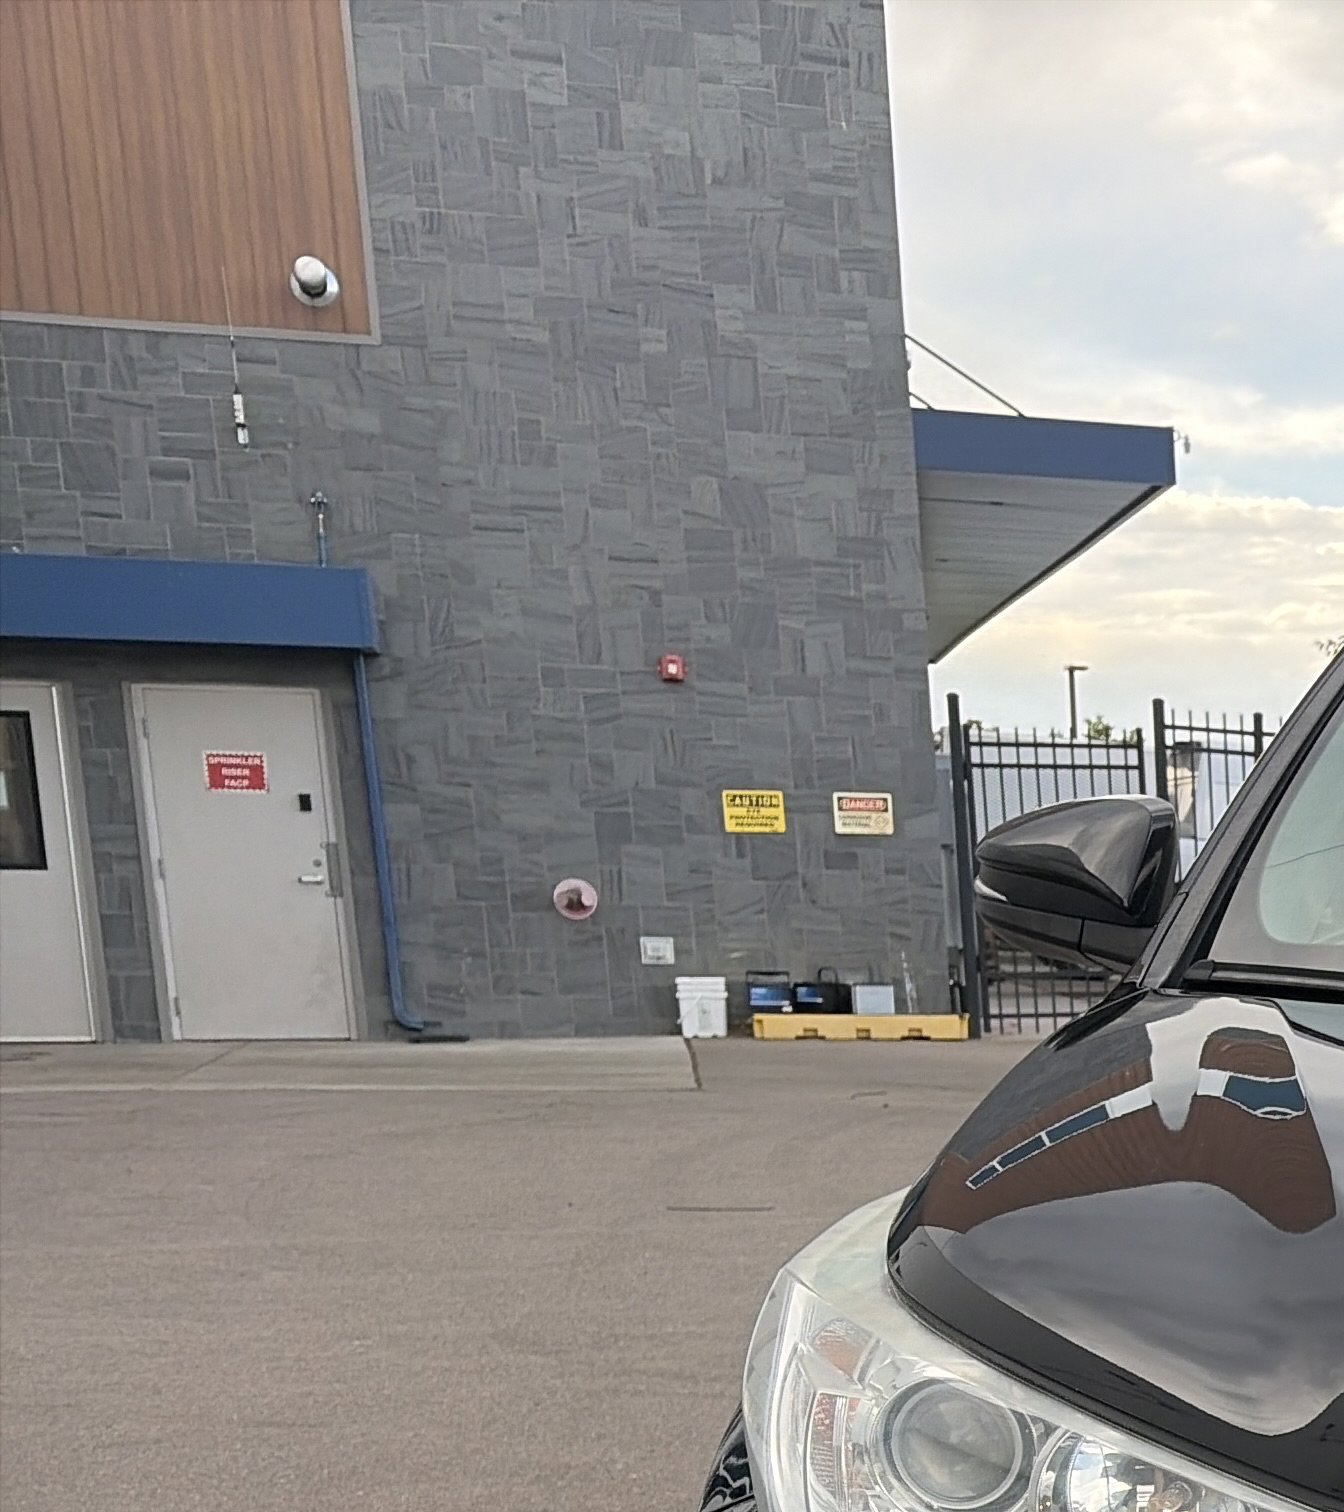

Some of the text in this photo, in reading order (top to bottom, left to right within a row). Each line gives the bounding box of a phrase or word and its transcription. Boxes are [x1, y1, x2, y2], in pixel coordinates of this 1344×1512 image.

[208, 756, 261, 765] SPRINKLER
[221, 767, 250, 777] RISER
[224, 779, 250, 787] FACP
[727, 794, 780, 807] CAUTION
[842, 798, 883, 810] DANGER
